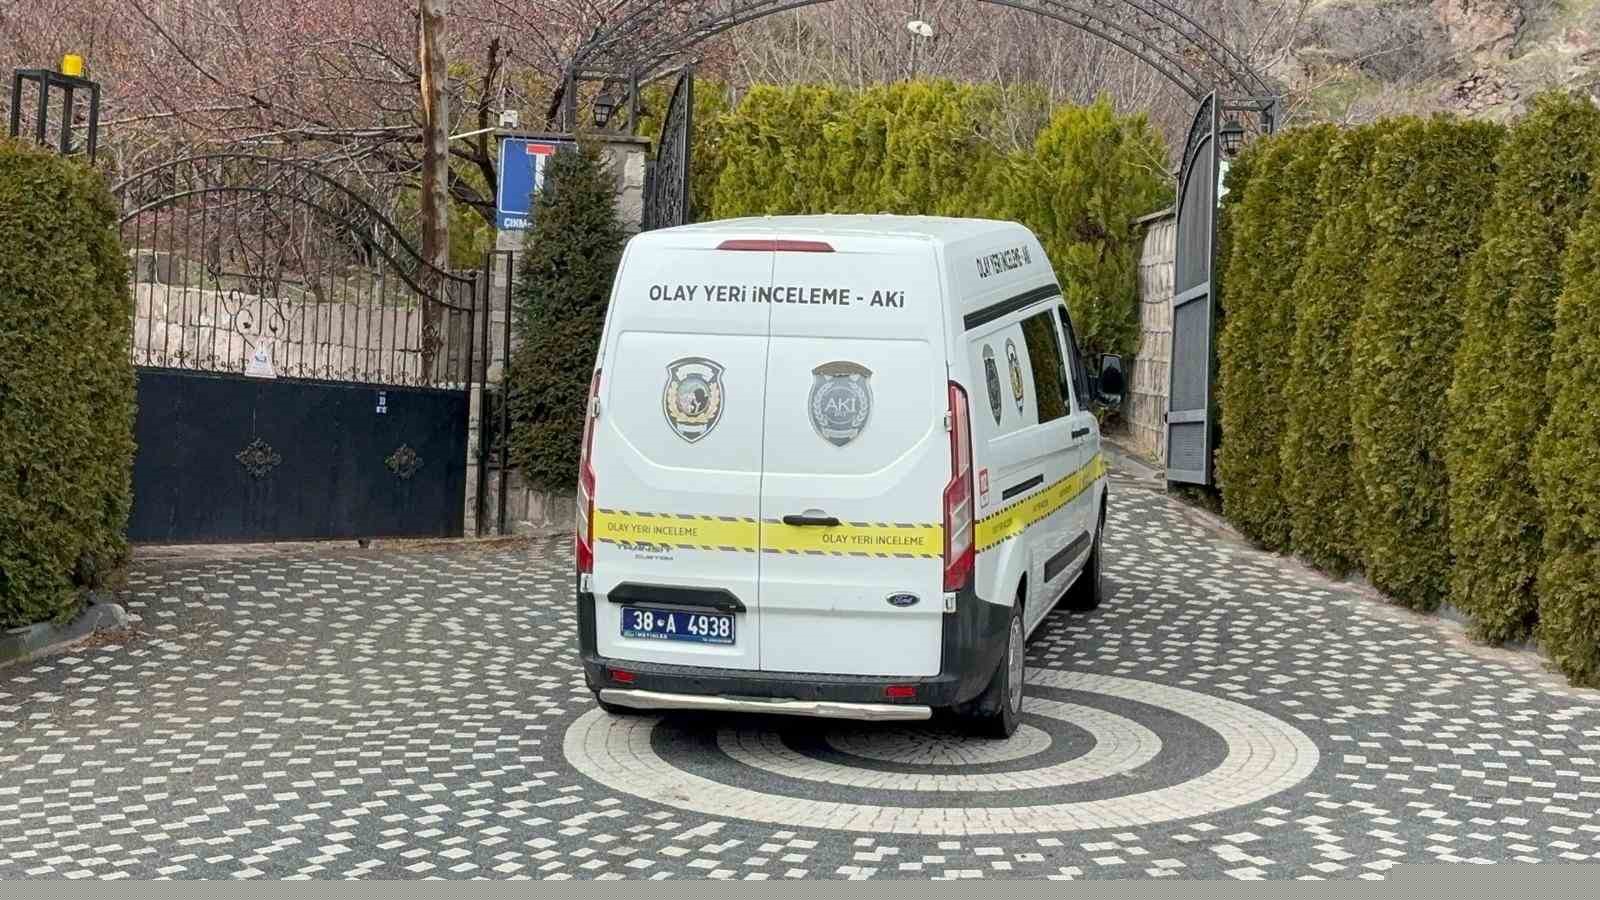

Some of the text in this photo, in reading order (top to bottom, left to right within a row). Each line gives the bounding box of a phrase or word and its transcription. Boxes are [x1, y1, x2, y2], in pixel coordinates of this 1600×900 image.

[649, 285, 698, 301] OLAY
[824, 398, 857, 413] AKI
[607, 522, 629, 533] OLAY
[822, 533, 848, 544] OLAY
[633, 611, 730, 637] 38 A 4938
